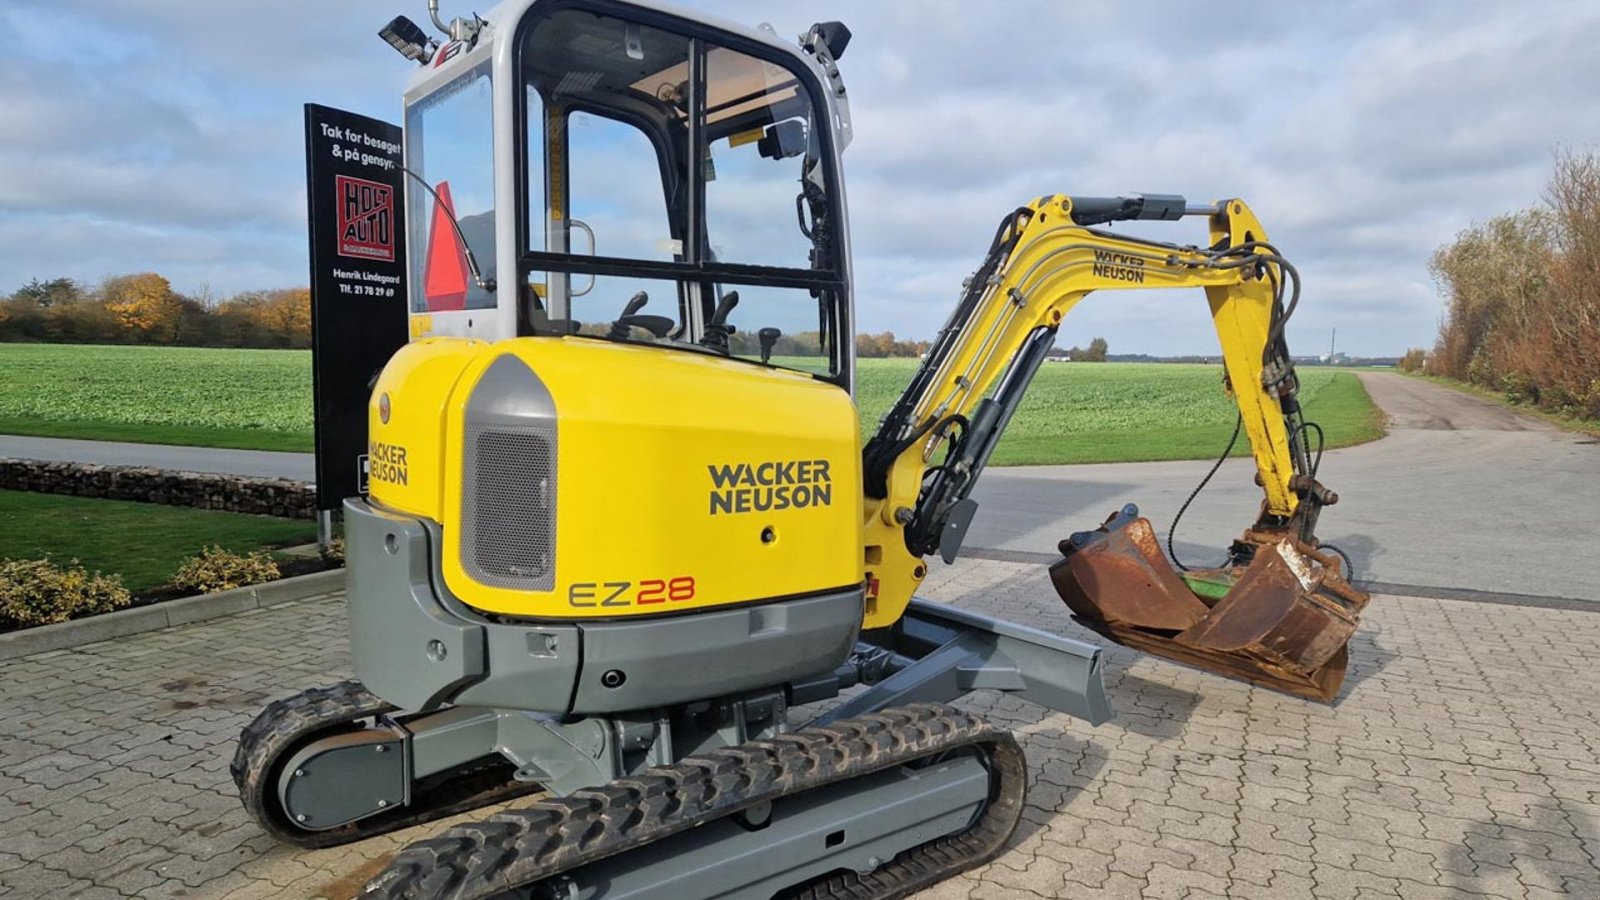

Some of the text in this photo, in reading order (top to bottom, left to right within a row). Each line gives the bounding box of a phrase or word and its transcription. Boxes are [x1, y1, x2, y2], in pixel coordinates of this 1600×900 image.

[320, 122, 401, 154] Tak for besøget
[332, 144, 343, 157] &
[344, 148, 360, 162] på
[344, 182, 388, 222] HOLT
[343, 207, 390, 245] AUTO
[333, 268, 400, 284] Henrik Lindegaard
[1093, 263, 1145, 284] NEUSON
[354, 284, 363, 295] 21
[364, 285, 374, 296] 78
[375, 286, 385, 296] 29
[708, 460, 831, 489] WACKER
[709, 484, 832, 515] NEUSON
